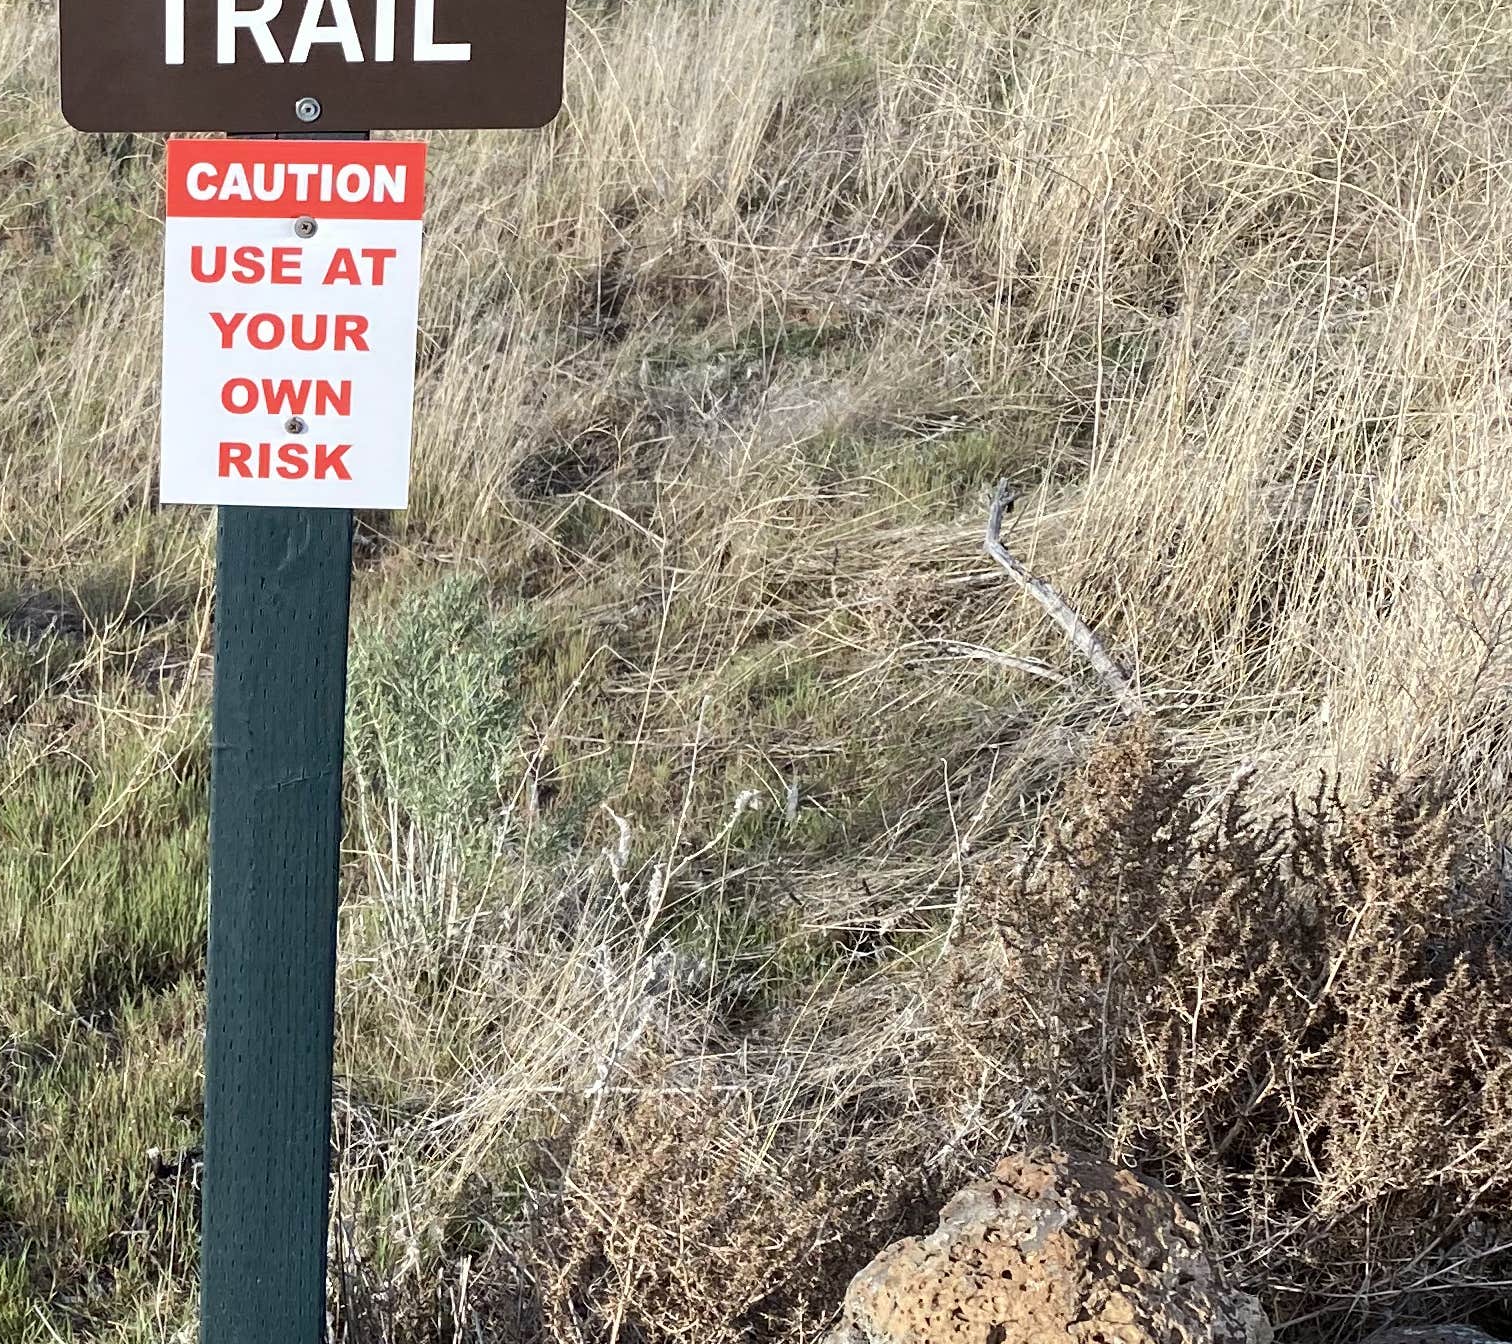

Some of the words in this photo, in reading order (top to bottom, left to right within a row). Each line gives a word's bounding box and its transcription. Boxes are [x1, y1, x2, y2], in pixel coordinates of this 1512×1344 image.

[187, 163, 407, 203] CAUTION
[191, 246, 303, 285] USE
[322, 248, 397, 286] AT
[209, 312, 369, 352] YOUR
[220, 378, 352, 417] OWN
[218, 442, 352, 481] RISK
